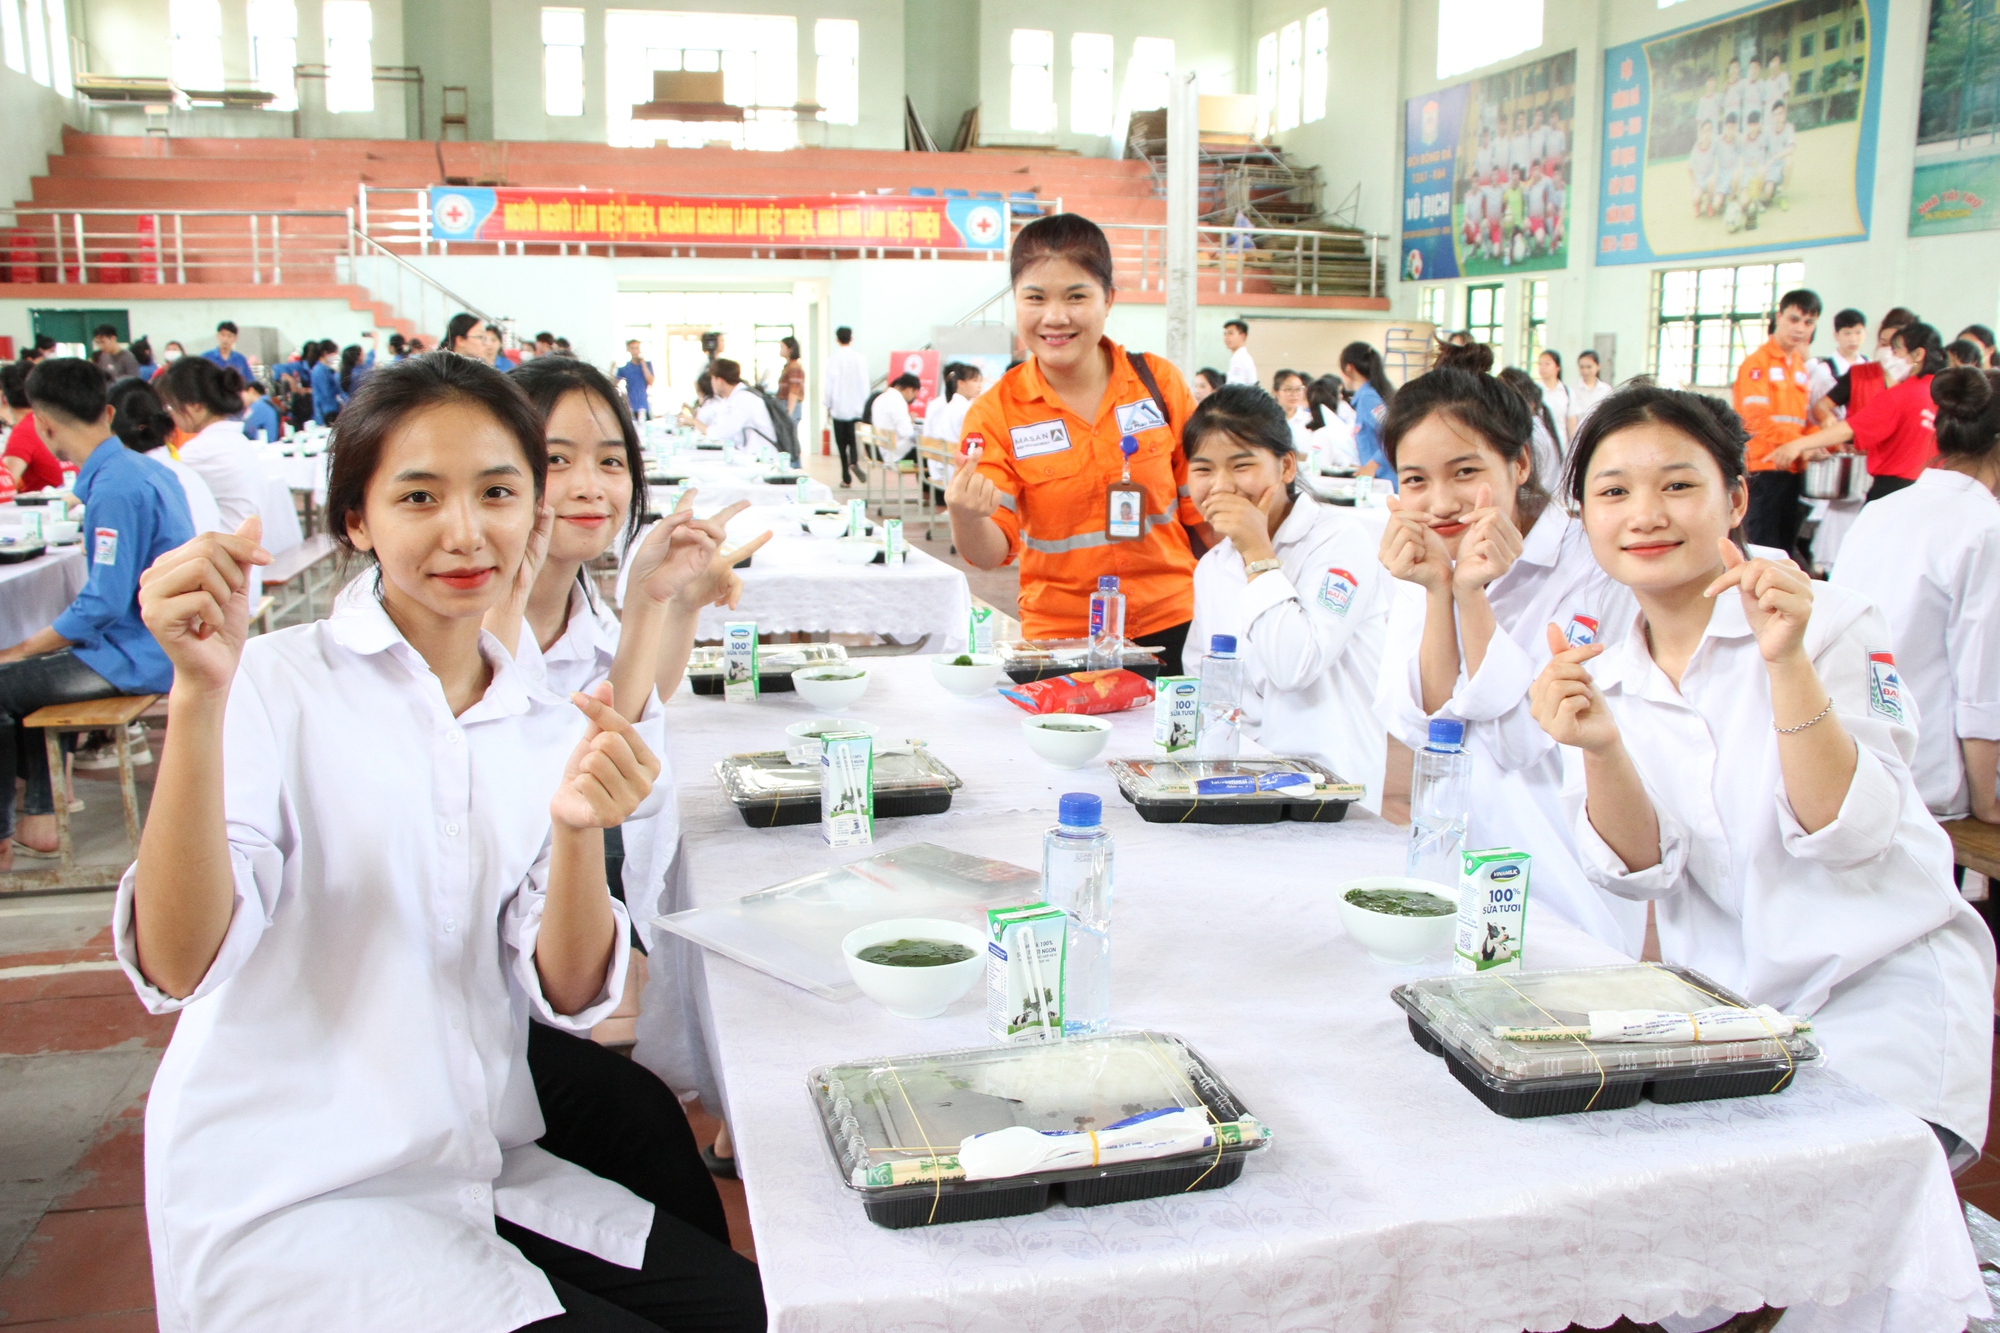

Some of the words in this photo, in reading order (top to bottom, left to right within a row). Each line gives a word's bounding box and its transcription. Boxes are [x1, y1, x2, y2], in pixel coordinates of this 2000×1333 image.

[1406, 192, 1421, 221] VÔ
[1014, 433, 1049, 445] MASAN
[1175, 699, 1196, 710] 100%
[1493, 869, 1518, 877] VINAMILK
[1489, 887, 1521, 903] 100%
[1482, 903, 1498, 915] SỮA
[1499, 904, 1521, 913] TƯƠI
